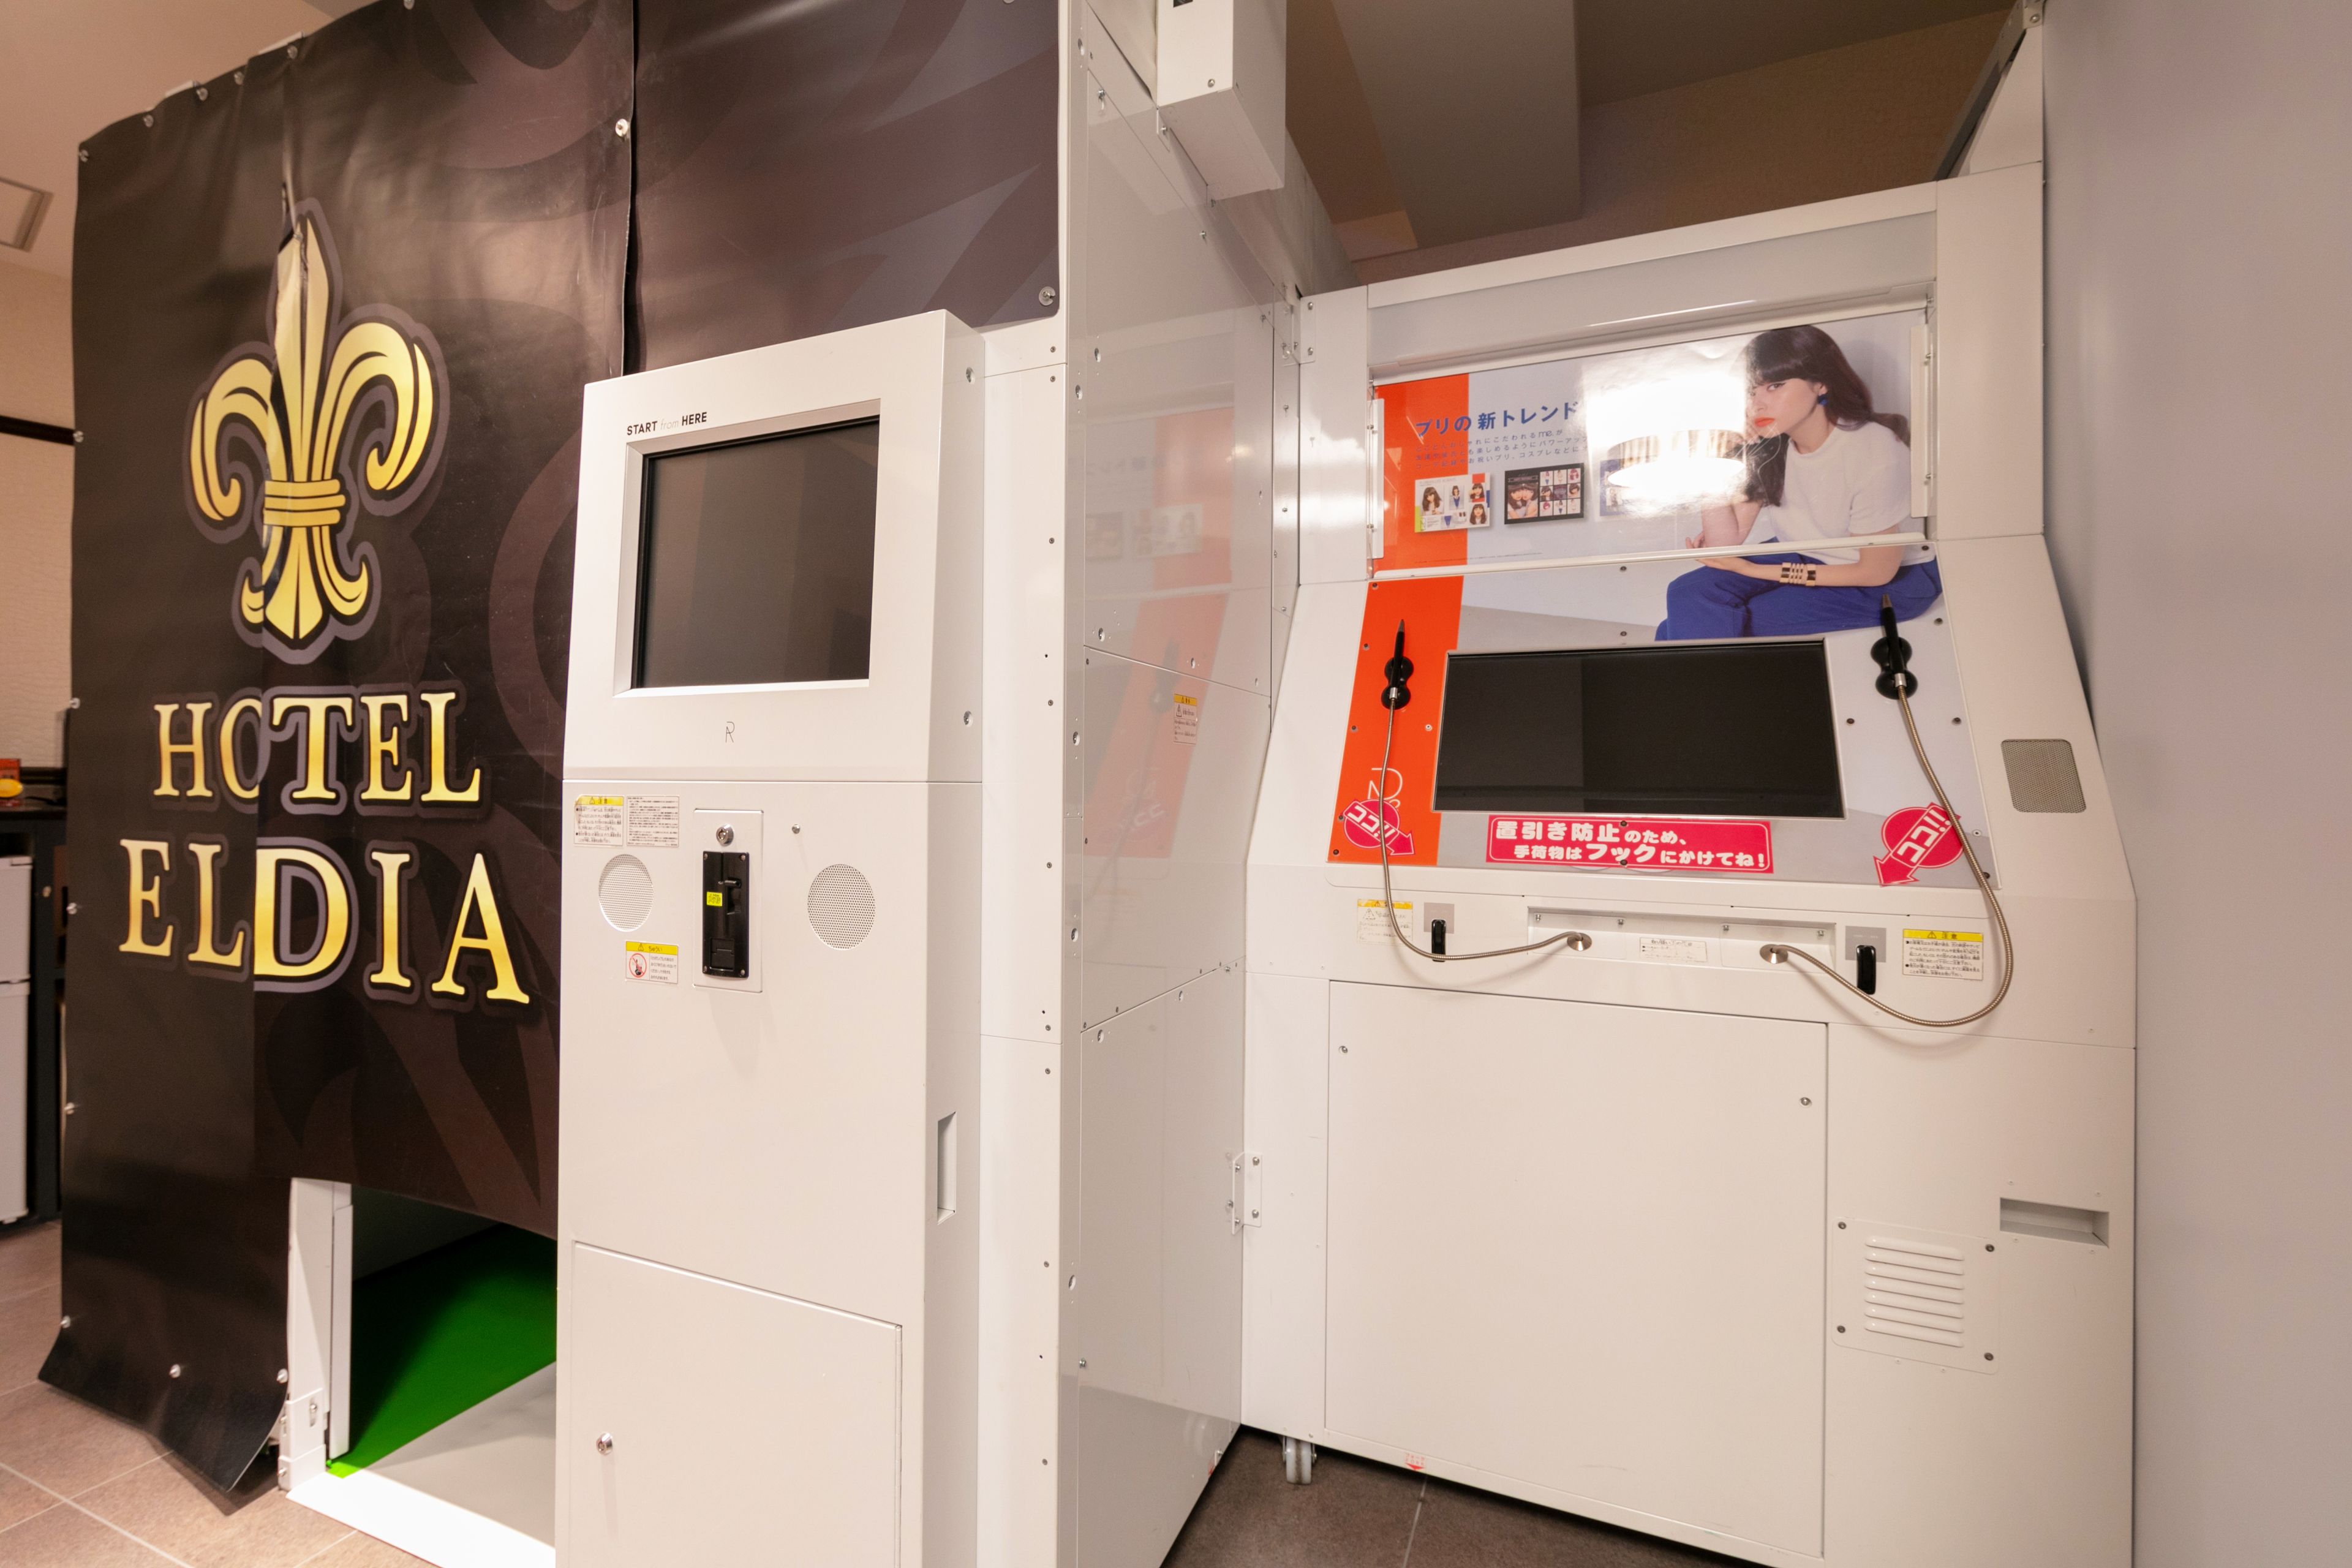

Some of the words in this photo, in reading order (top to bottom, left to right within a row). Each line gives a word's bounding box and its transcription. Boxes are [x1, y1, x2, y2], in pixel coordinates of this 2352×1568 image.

[627, 420, 658, 435] START
[660, 418, 679, 431] from
[682, 412, 707, 426] HERE
[153, 691, 481, 802] HOTEL
[1495, 821, 1687, 845] 置引き防止のため、
[119, 839, 530, 1004] ELDIA
